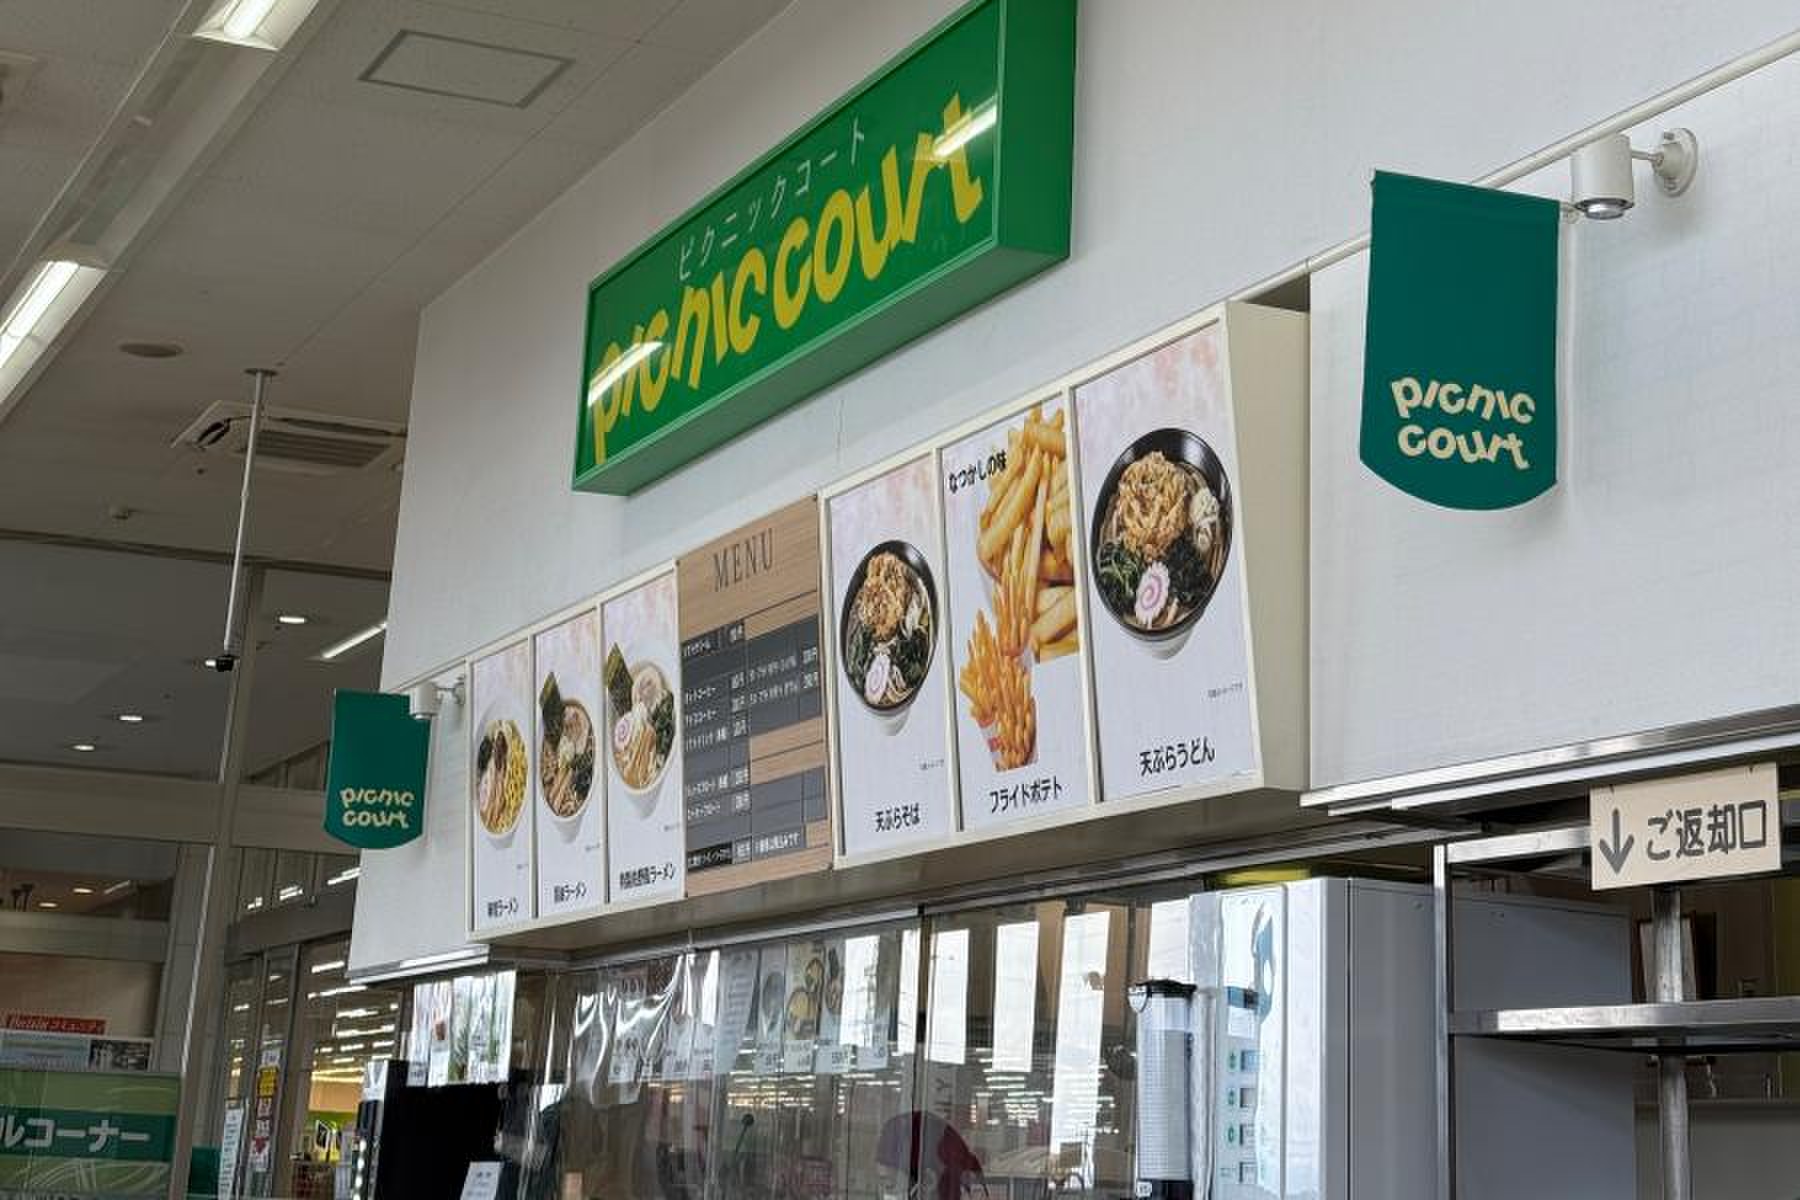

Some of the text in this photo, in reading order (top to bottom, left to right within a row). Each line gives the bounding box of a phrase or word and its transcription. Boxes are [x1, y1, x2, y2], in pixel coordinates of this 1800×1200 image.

[678, 115, 865, 281] ピクニックコート
[589, 91, 984, 466] picnic court
[1391, 376, 1536, 425] picnic
[1397, 424, 1531, 470] court
[712, 527, 774, 593] MENU
[1138, 736, 1216, 777] 天ぷらうどん
[340, 786, 416, 809] picnic
[874, 801, 921, 834] 天ぷらそば
[989, 775, 1063, 814] フライドポテト
[342, 809, 410, 829] court
[1647, 799, 1767, 861] ご返却口
